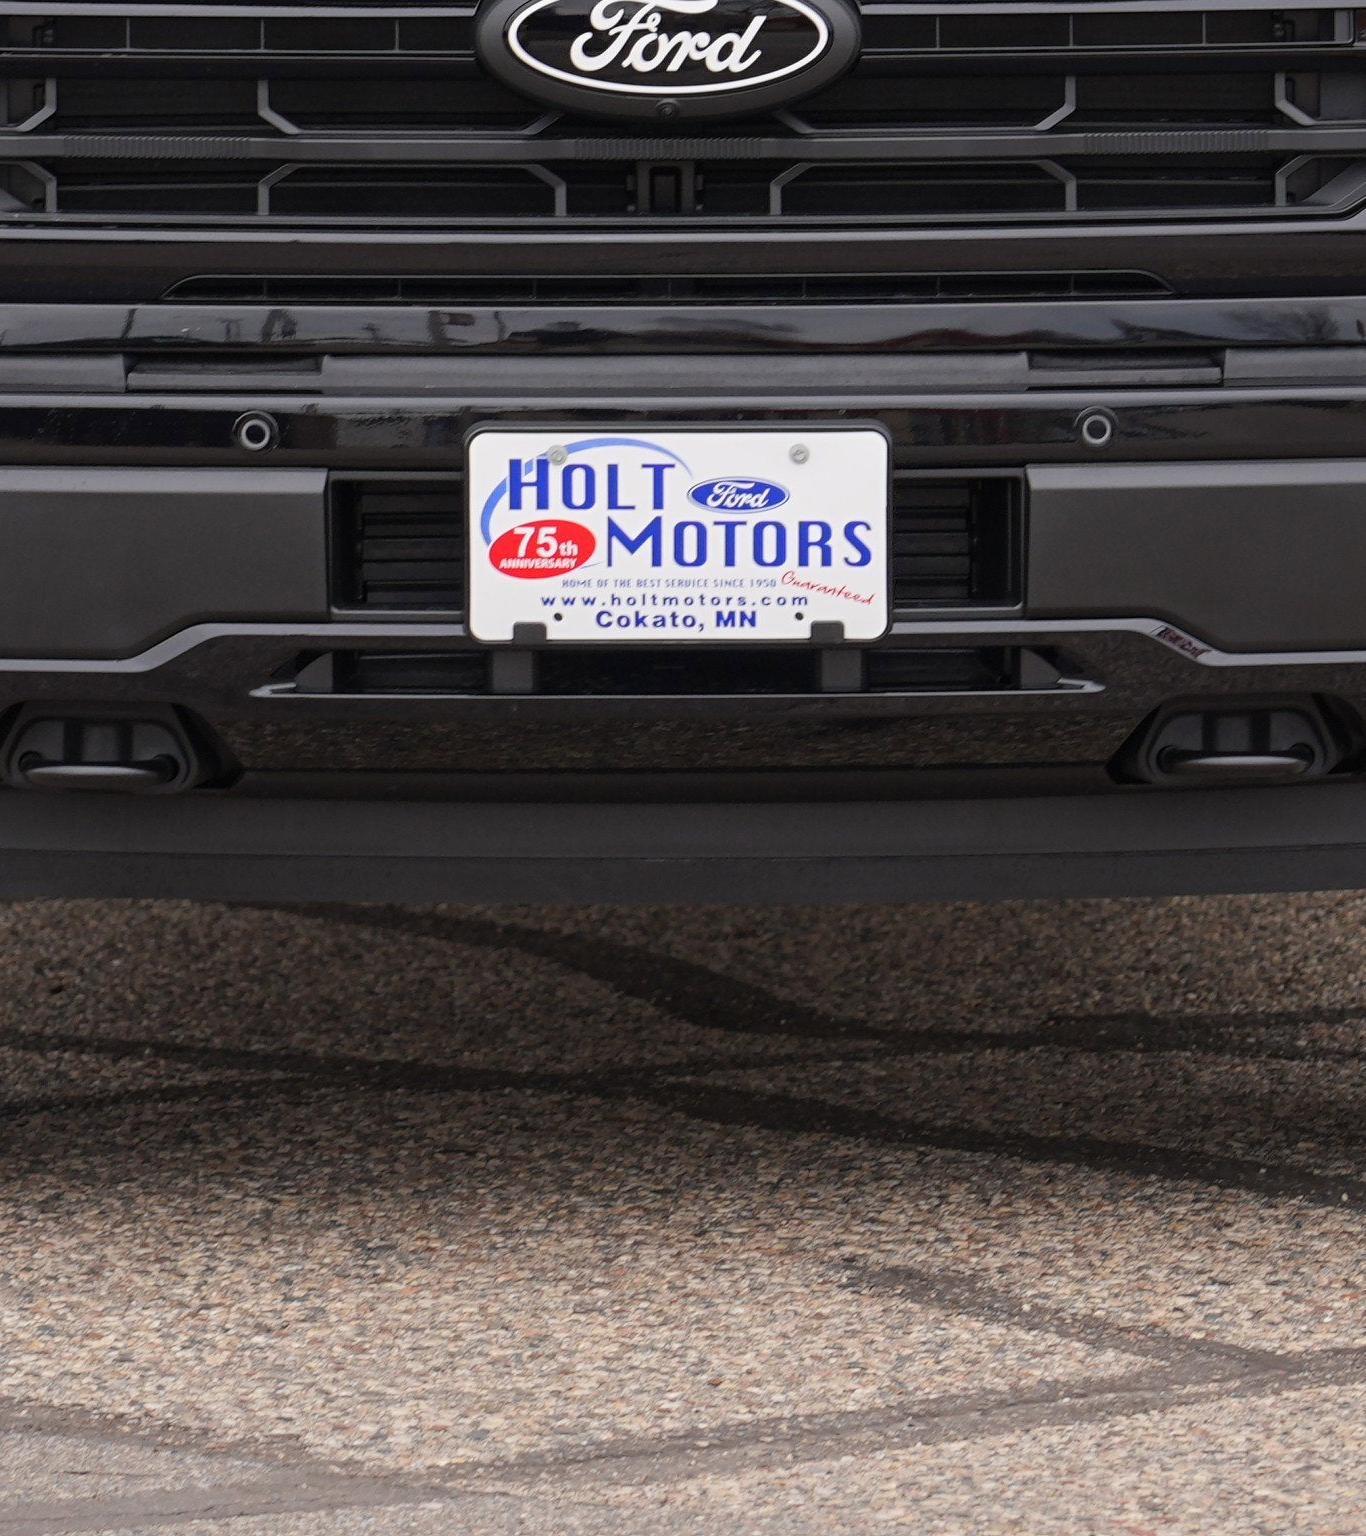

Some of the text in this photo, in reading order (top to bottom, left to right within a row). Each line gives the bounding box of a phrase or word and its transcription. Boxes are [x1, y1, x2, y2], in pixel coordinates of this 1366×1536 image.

[509, 458, 675, 510] HOLT
[705, 480, 772, 508] Ford
[513, 525, 579, 558] 75th
[606, 515, 872, 568] MOTORS
[498, 557, 578, 570] ANNIVERSARY
[562, 578, 592, 589] HOME
[596, 578, 609, 589] OF
[614, 578, 632, 589] THE
[636, 578, 661, 589] BEST
[665, 578, 710, 589] SERVICE
[713, 578, 745, 589] SINCE
[781, 570, 876, 605] Guaranteed
[541, 593, 808, 606] www.holtmotors.com
[595, 610, 757, 632] Cokato, MN
